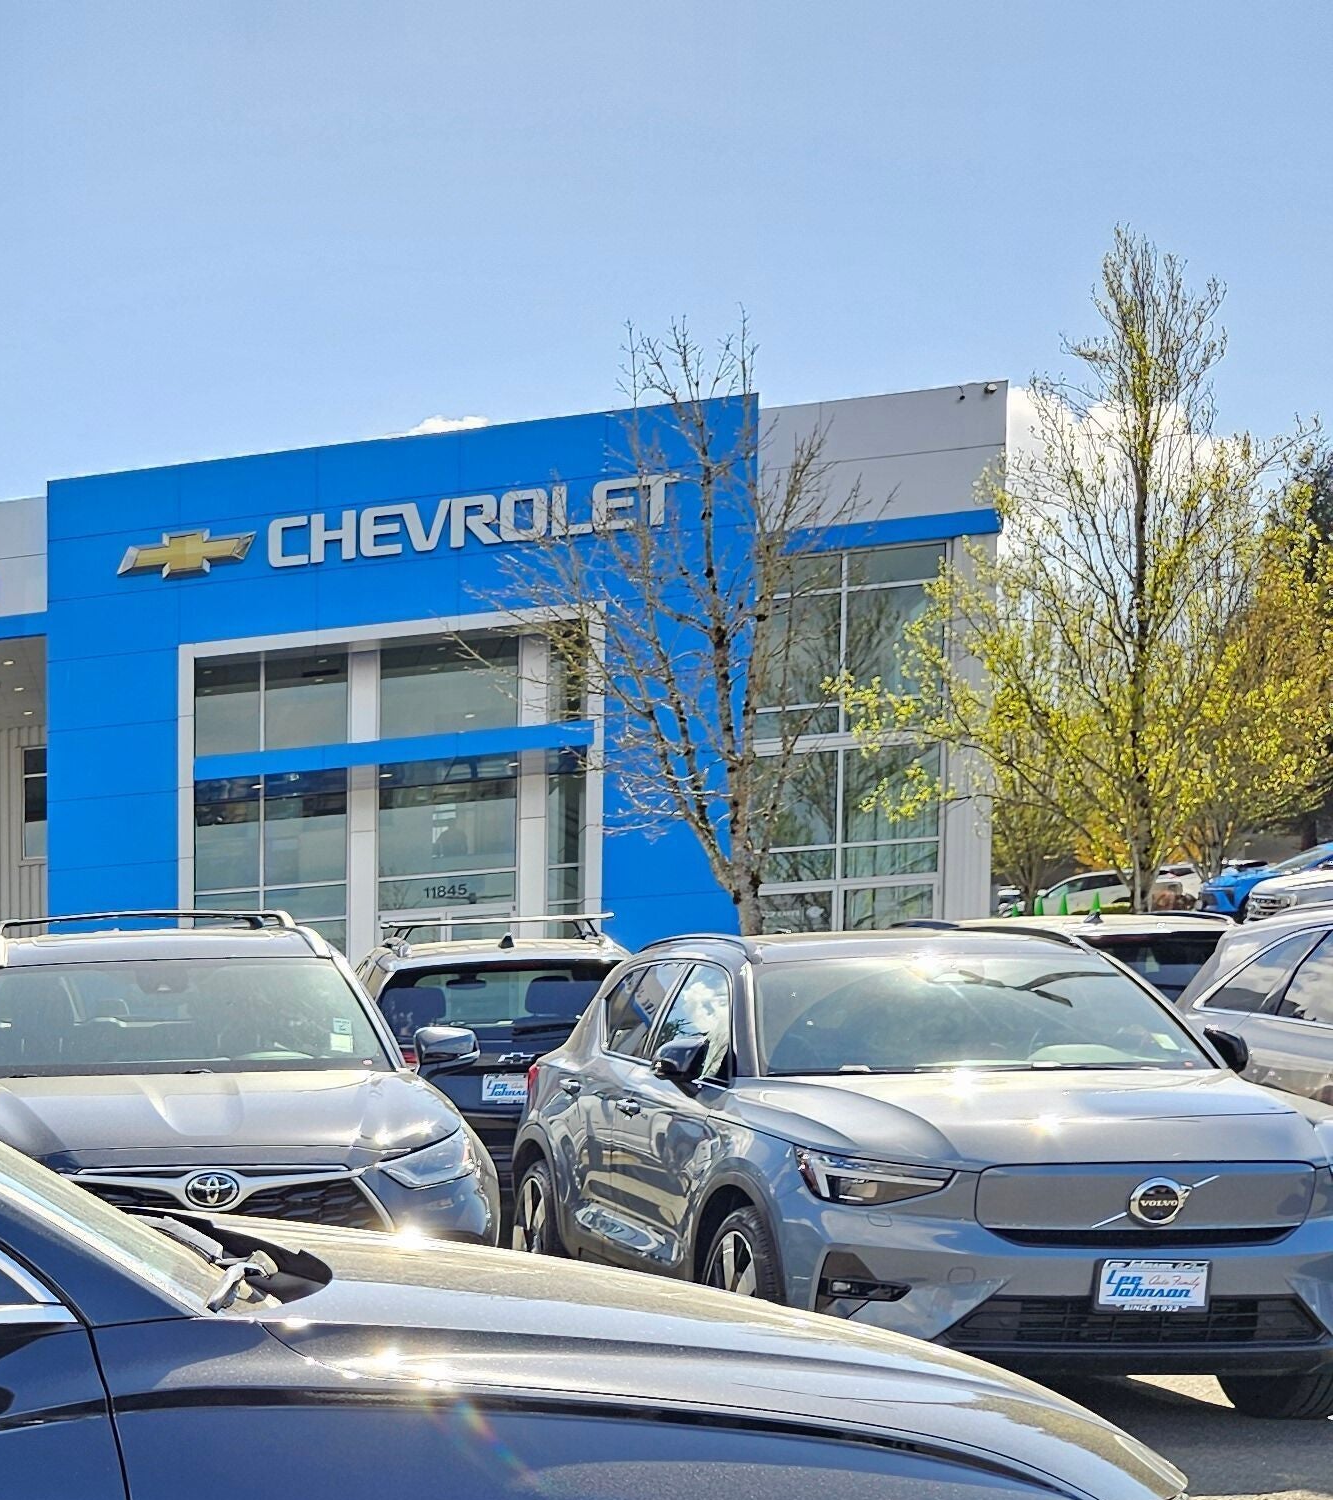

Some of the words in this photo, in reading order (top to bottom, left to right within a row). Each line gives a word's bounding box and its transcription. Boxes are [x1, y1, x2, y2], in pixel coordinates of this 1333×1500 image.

[267, 472, 681, 569] CHEVROLET
[424, 884, 468, 899] 11845
[1106, 1269, 1144, 1285] Lee
[1106, 1281, 1192, 1298] Johnson
